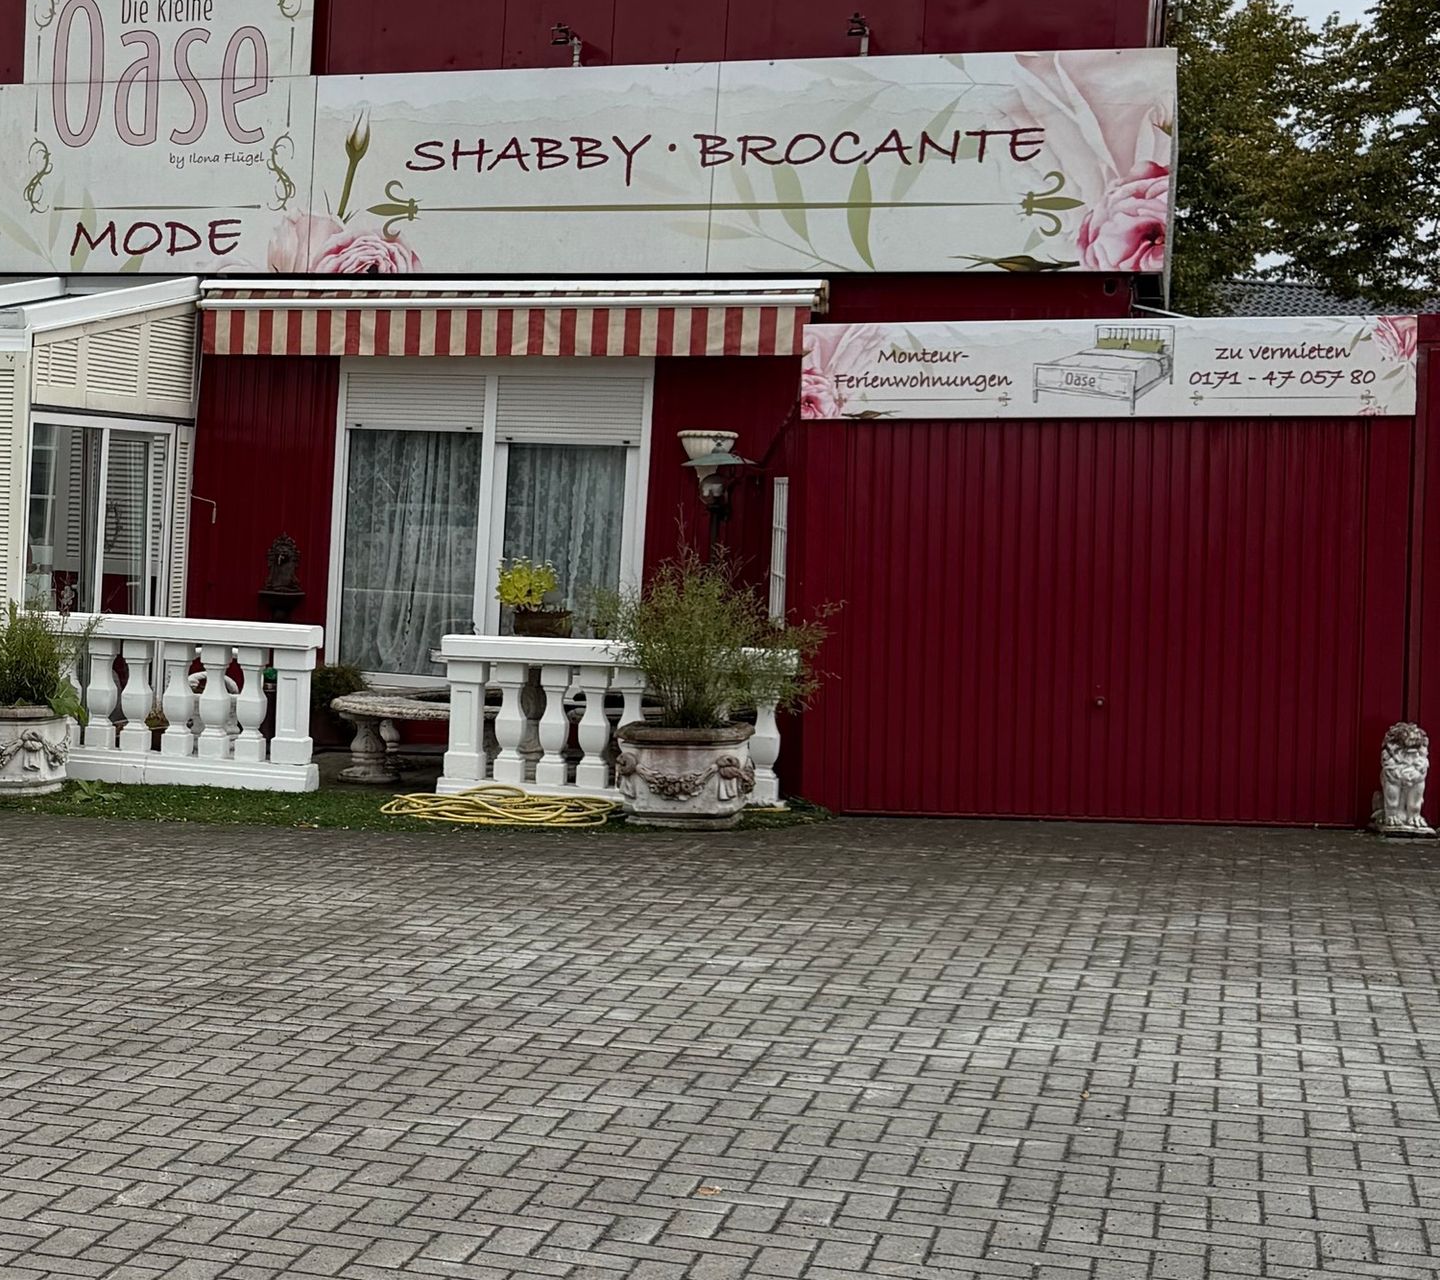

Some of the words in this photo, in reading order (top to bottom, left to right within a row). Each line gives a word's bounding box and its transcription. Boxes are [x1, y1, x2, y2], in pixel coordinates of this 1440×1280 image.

[169, 152, 185, 169] by
[189, 152, 220, 164] Ilona
[224, 151, 265, 166] Flügel
[405, 134, 652, 186] SHABBY
[694, 127, 1046, 169] BROCANTE
[70, 219, 242, 257] MODE
[877, 349, 970, 364] Monteur-
[1215, 346, 1244, 360] zu
[1249, 341, 1352, 360] vermieten
[833, 371, 1013, 393] Ferienwohnungen
[1064, 372, 1096, 388] Oase
[1189, 370, 1242, 389] 0171
[1262, 370, 1295, 389] 47
[1300, 370, 1345, 389] 057
[1350, 370, 1376, 385] 80
